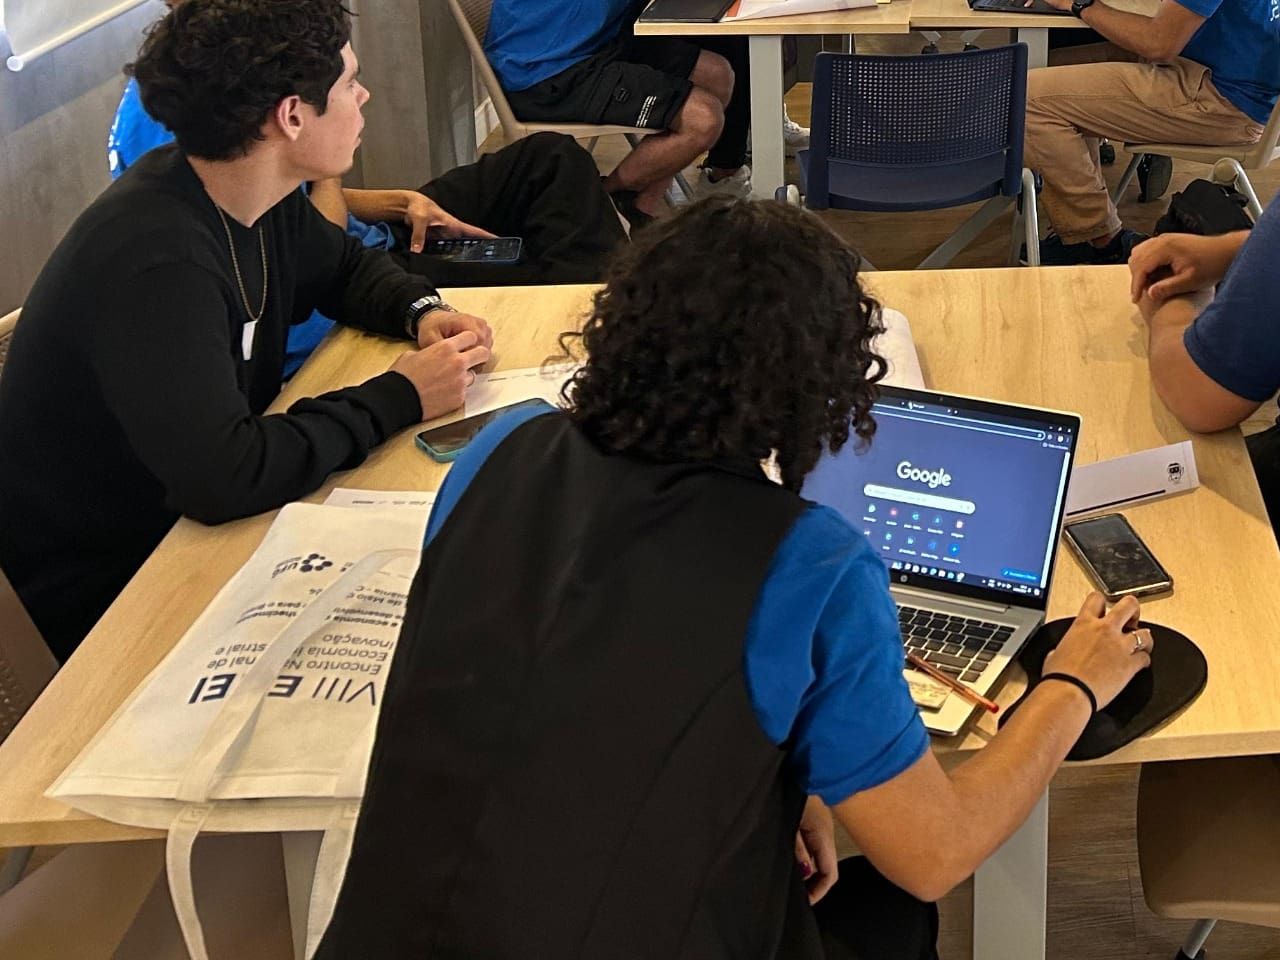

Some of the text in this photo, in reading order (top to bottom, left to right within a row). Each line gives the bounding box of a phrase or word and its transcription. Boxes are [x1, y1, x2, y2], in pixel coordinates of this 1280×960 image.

[896, 460, 952, 488] Google
[355, 593, 385, 604] Maio
[215, 647, 226, 656] e
[307, 646, 389, 662] Economia
[207, 657, 228, 670] de
[306, 660, 383, 676] Encontro
[187, 673, 377, 706] VIII EEI
